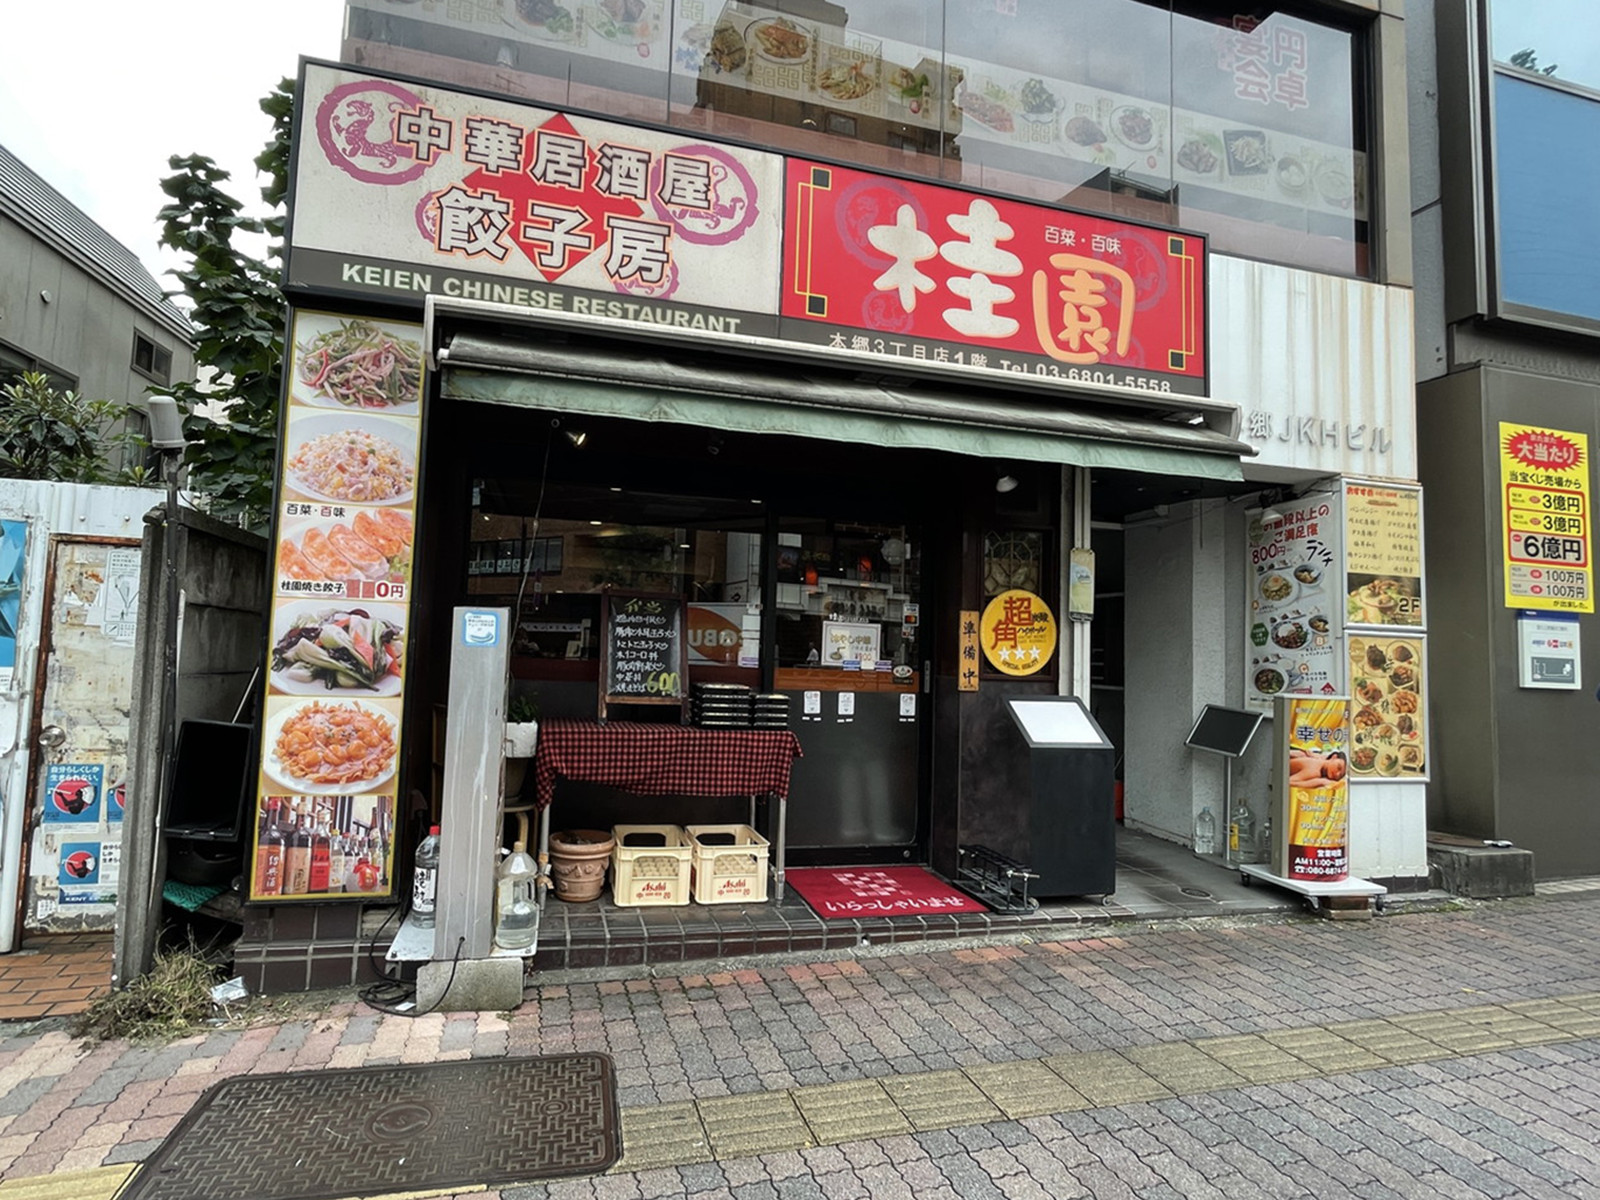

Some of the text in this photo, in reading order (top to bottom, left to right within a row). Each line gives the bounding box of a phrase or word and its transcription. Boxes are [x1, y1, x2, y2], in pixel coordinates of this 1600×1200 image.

[1273, 25, 1309, 110] 円卓
[395, 106, 712, 210] 中華居酒屋
[436, 187, 673, 285] 餃子房
[1044, 224, 1122, 255] 百菜・百味
[866, 198, 1137, 365] 桂園
[342, 263, 742, 334] KEIEN CHINESE RESTAURANT
[1241, 410, 1392, 454] 郷JKHビル
[1516, 440, 1575, 465] 大当たり
[1509, 470, 1582, 489] 当宝くじ売場から
[287, 503, 346, 518] 百菜・百味
[1542, 494, 1580, 513] 3億円
[1273, 523, 1319, 544] ご満足度
[1543, 515, 1581, 534] 3億円
[1306, 539, 1333, 567] ランチ
[1523, 535, 1581, 561] 6億円
[281, 580, 344, 594] 桂園焼き餃子
[1545, 570, 1584, 585] 100万円
[1546, 584, 1585, 599] 100万円
[1003, 596, 1034, 626] 超
[1399, 597, 1420, 613] 2F
[991, 619, 1018, 650] 角
[963, 621, 978, 685] 準備中
[641, 882, 667, 893] Asahi
[722, 879, 747, 889] Asahi
[825, 897, 964, 911] いらっしゃいませ
